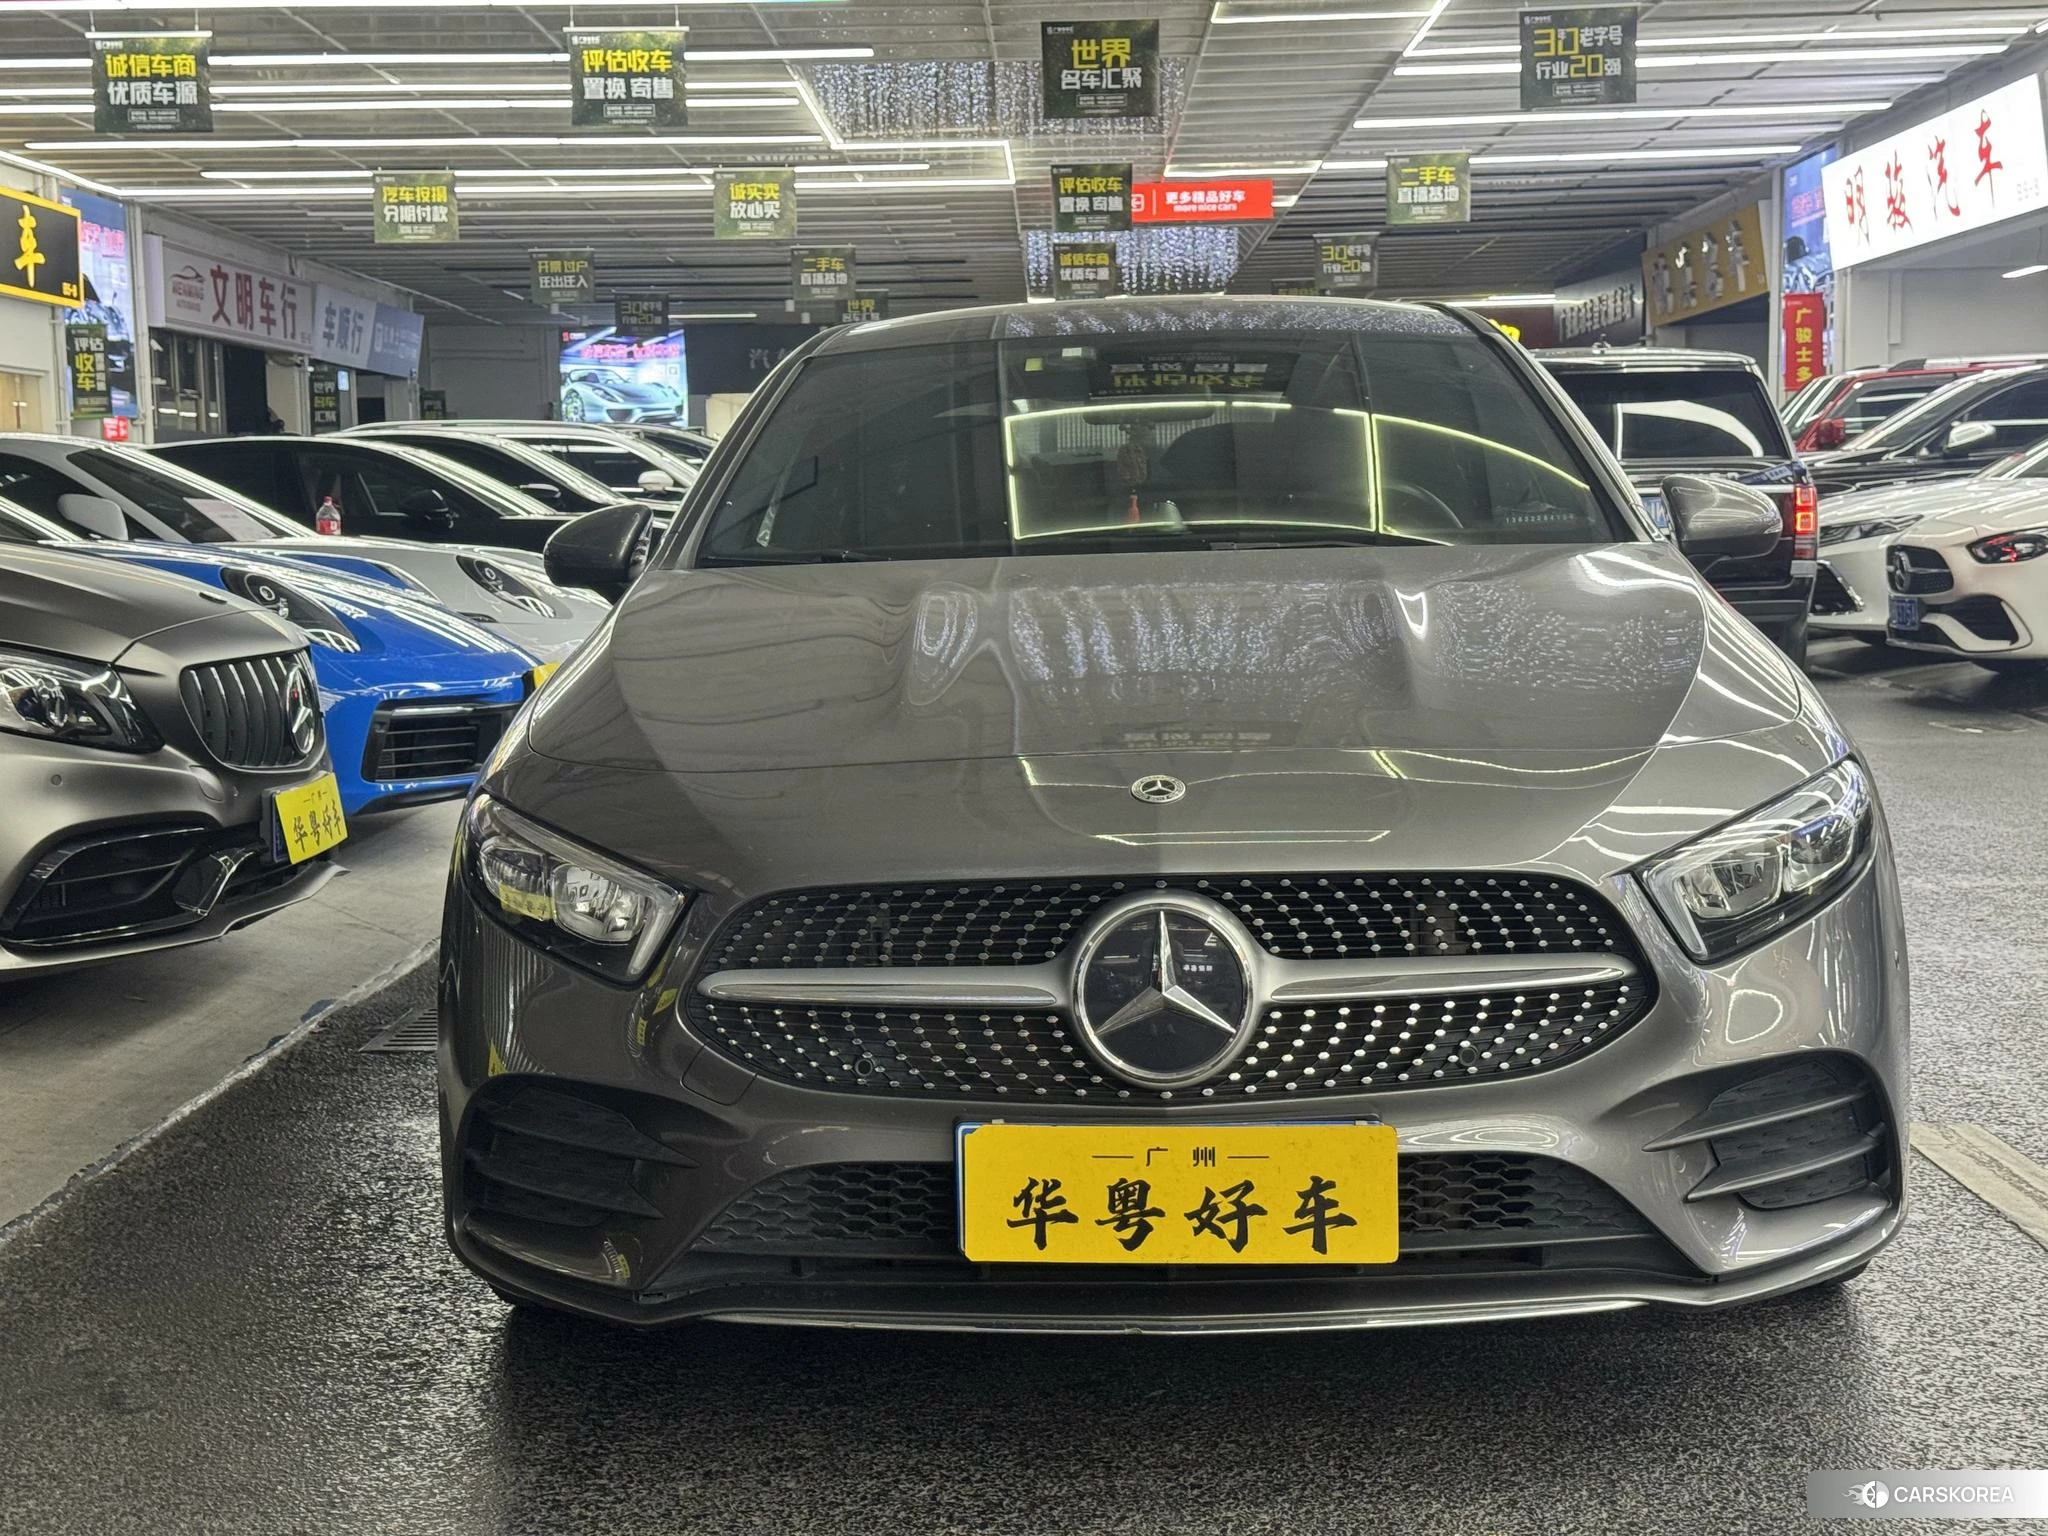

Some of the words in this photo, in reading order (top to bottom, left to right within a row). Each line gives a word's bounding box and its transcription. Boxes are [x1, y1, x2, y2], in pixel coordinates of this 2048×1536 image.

[582, 49, 673, 73] 评估收车
[1071, 38, 1131, 69] 世界
[105, 54, 196, 77] 诚信车商
[1536, 54, 1621, 80] 行业20强
[583, 77, 627, 99] 置换
[629, 77, 673, 99] 寄售
[1061, 67, 1142, 90] 名车汇聚
[107, 81, 198, 105] 优质车源
[1059, 177, 1123, 193] 评估收车
[1400, 166, 1456, 185] 二手车
[383, 205, 449, 223] 分期付款
[729, 201, 781, 219] 放心买
[14, 204, 46, 288] 车
[803, 257, 845, 272] 二手车
[210, 264, 298, 340] 文明车行
[75, 353, 96, 391] 收车
[1146, 1147, 1216, 1168] 广州
[1006, 1174, 1358, 1255] 华粤好车
